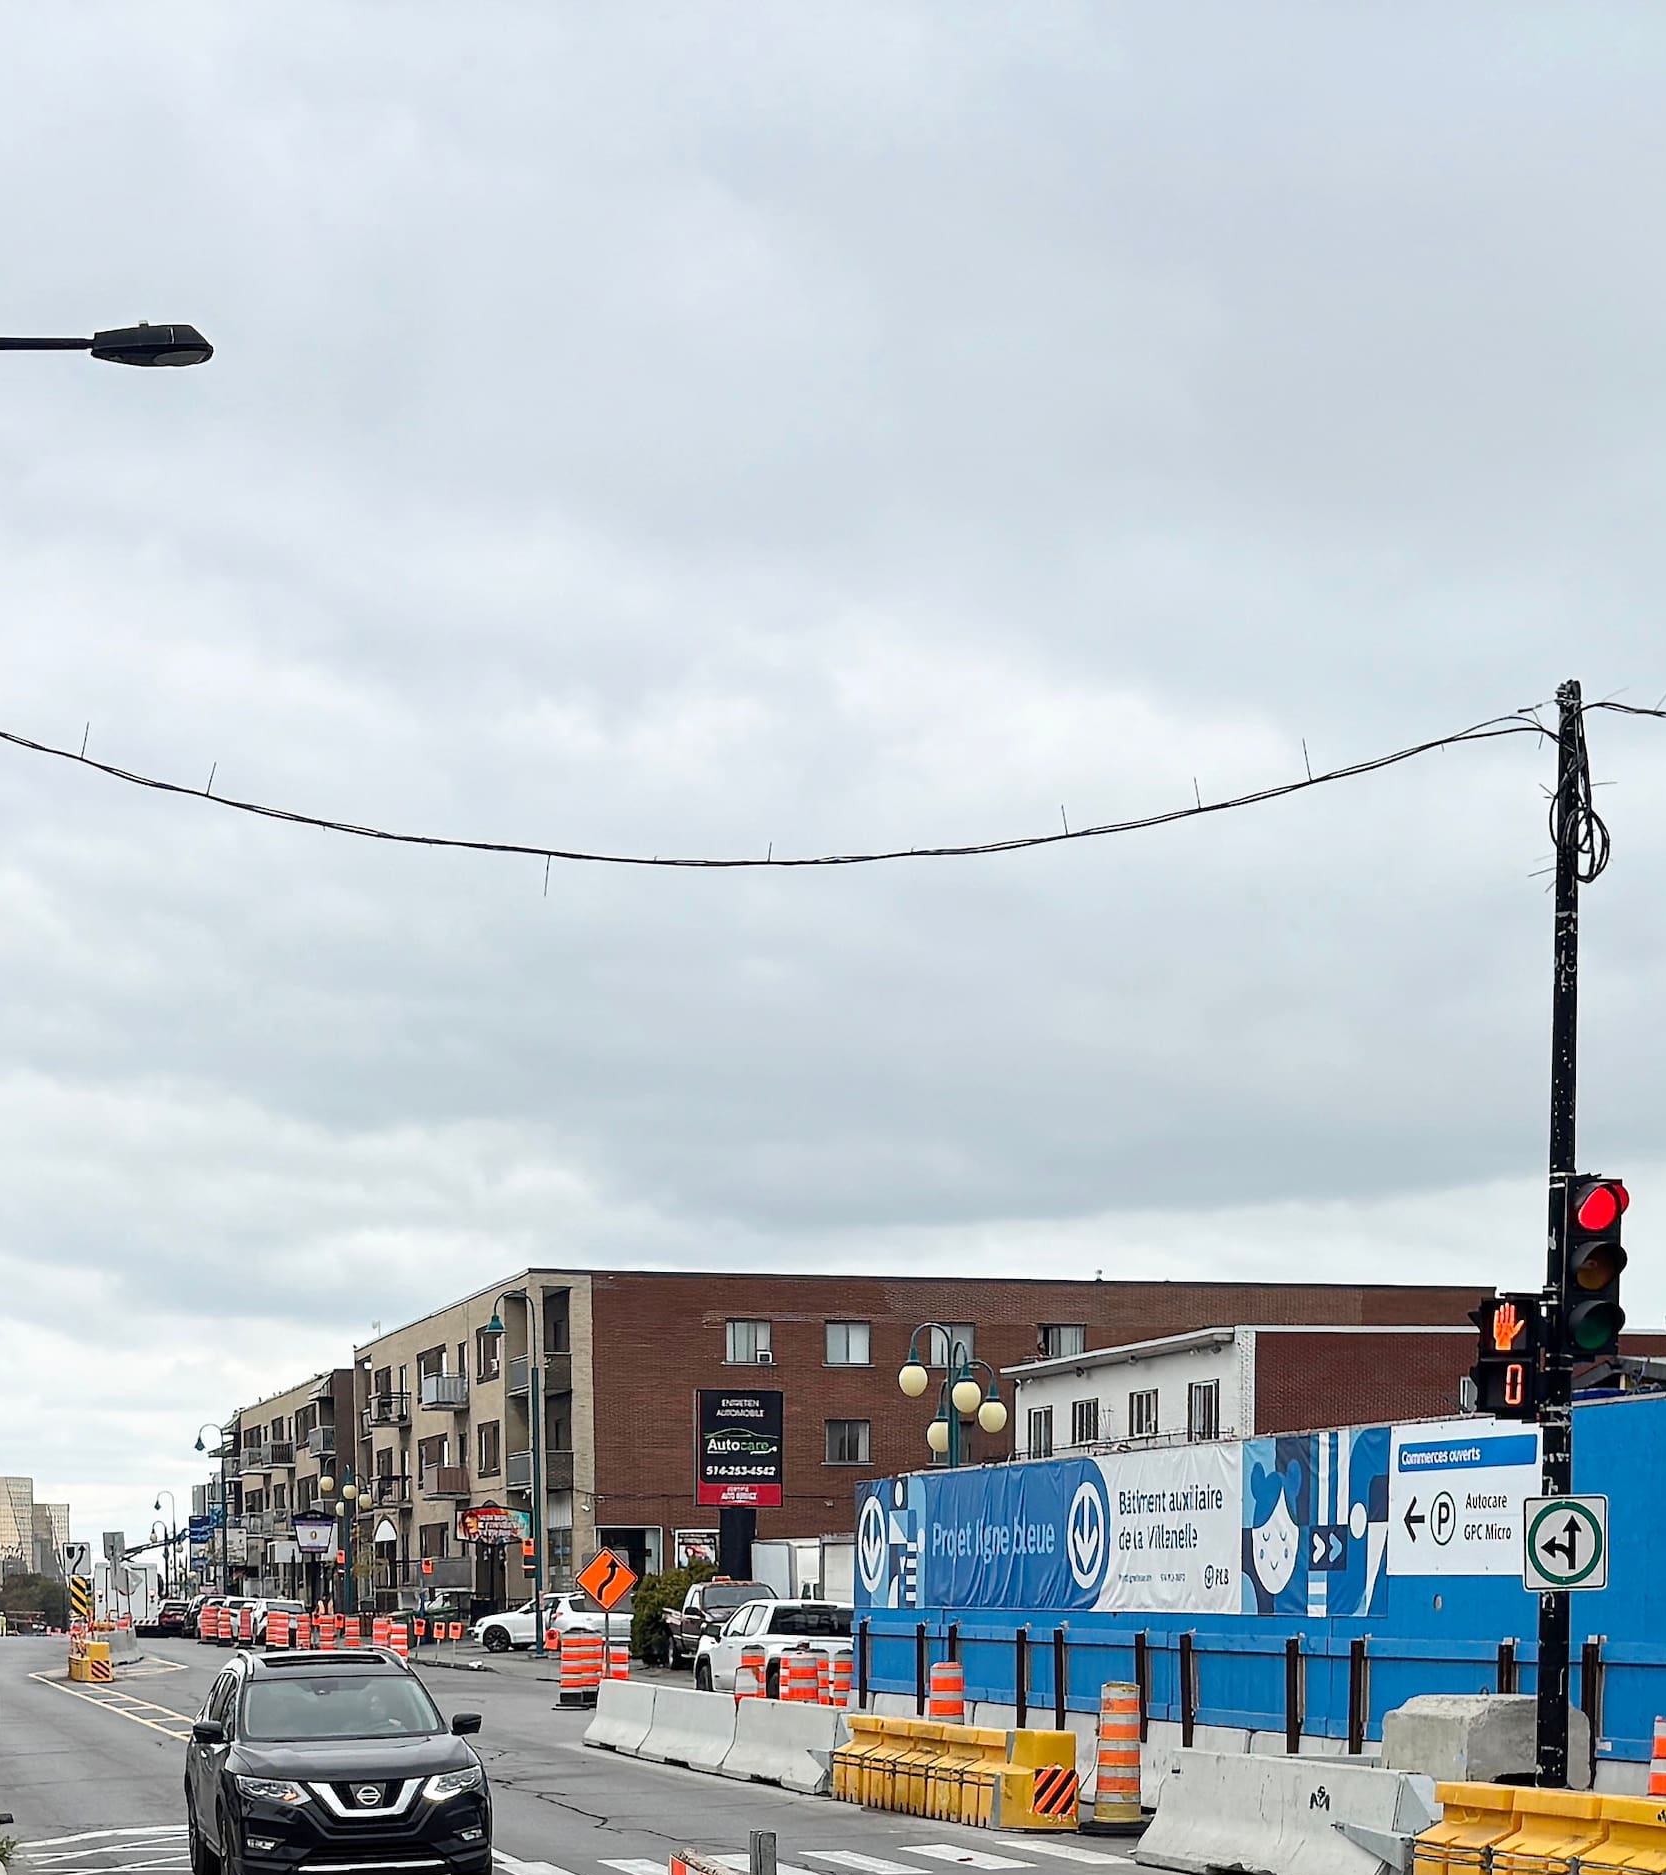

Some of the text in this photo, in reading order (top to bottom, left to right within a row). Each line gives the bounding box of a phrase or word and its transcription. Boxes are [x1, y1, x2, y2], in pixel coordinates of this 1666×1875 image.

[707, 1438, 769, 1451] Autocare
[1402, 1447, 1481, 1465] Commerces ouverts
[1119, 1483, 1223, 1515] Bâtiment auxiliaire
[1465, 1493, 1508, 1509] Autocare
[932, 1516, 1055, 1565] Projet ligne bleue
[1119, 1522, 1198, 1551] de la Villanelle
[1464, 1523, 1511, 1541] GPC Micro
